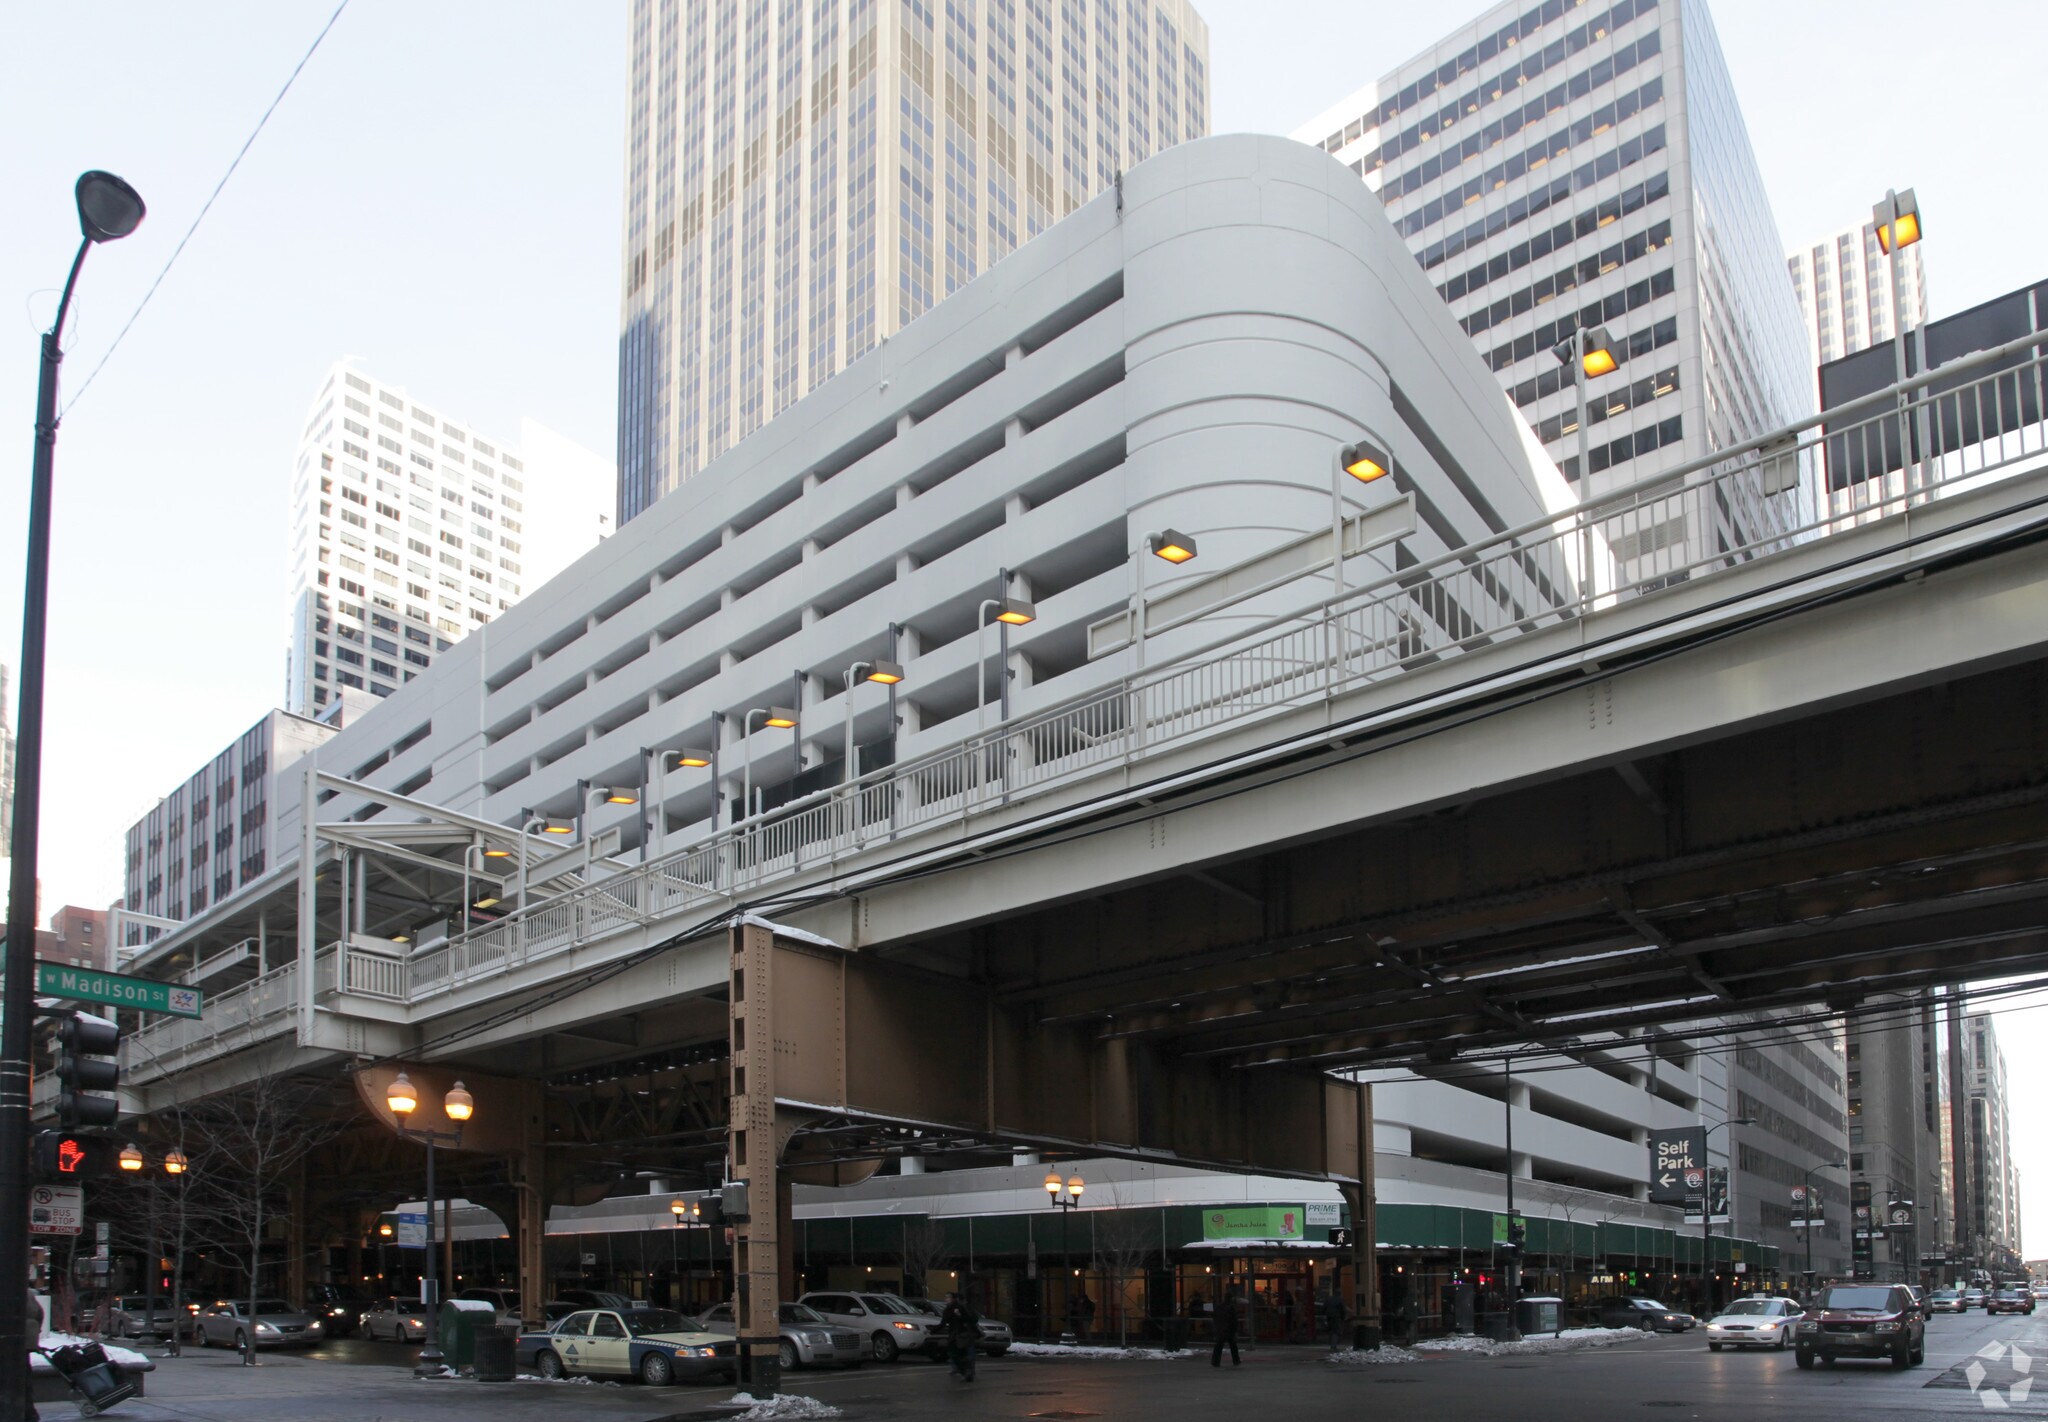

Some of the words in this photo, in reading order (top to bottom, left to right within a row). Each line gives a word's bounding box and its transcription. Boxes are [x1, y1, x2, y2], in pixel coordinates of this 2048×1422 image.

[46, 974, 56, 984] W
[61, 972, 148, 1002] Madison
[152, 991, 164, 1001] St
[1658, 1140, 1690, 1156] Self
[1658, 1155, 1694, 1170] Park
[52, 1209, 71, 1217] BUS
[52, 1217, 75, 1225] STOP
[55, 1226, 76, 1234] ZONE
[1591, 1275, 1614, 1284] ATM
